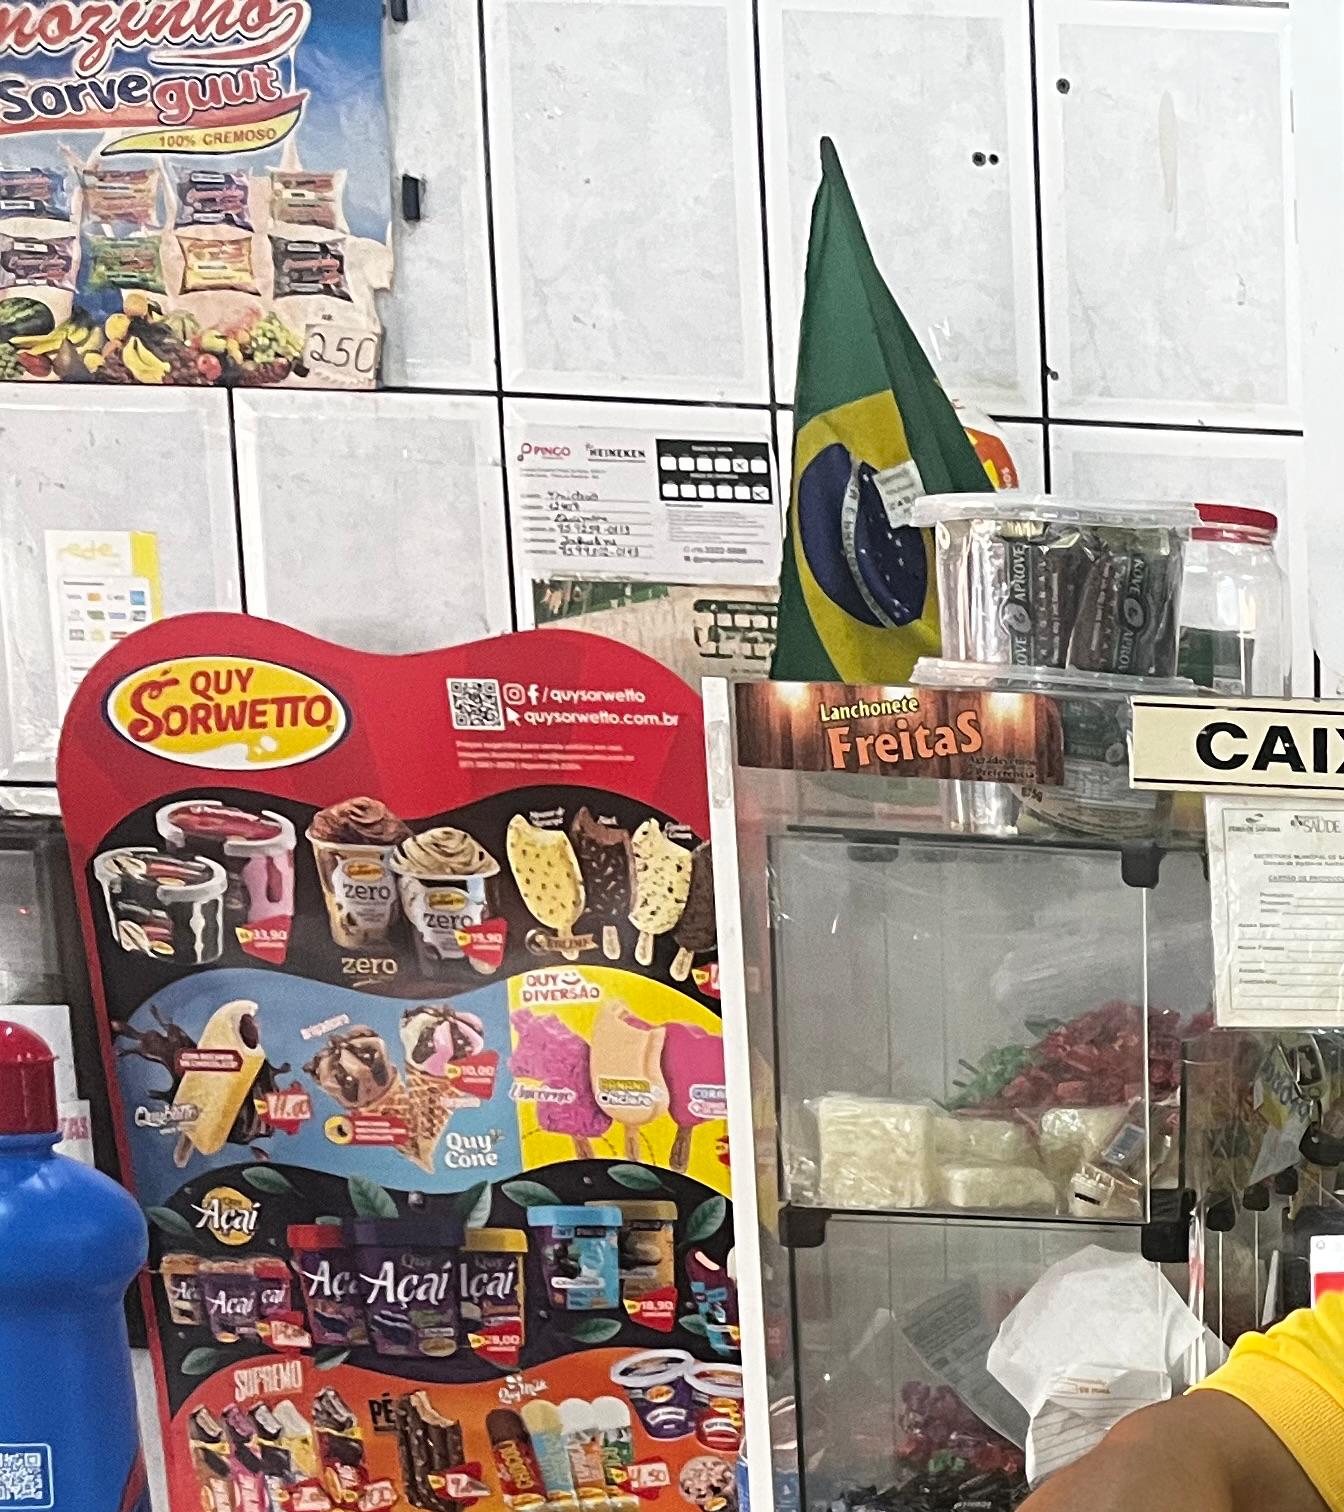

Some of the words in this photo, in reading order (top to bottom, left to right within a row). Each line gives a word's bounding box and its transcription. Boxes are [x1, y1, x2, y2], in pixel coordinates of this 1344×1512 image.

[203, 128, 278, 146] CREMOSO
[189, 668, 255, 701] QUY
[128, 675, 335, 743] SORWETTO
[819, 695, 919, 722] Lanchonete
[523, 711, 679, 728] quysorwetto.com.br
[343, 883, 391, 900] zero
[423, 911, 474, 930] zero
[341, 956, 398, 975] zero
[445, 1132, 492, 1152] Quy
[444, 1150, 498, 1168] Cone
[191, 1199, 261, 1236] Açaí
